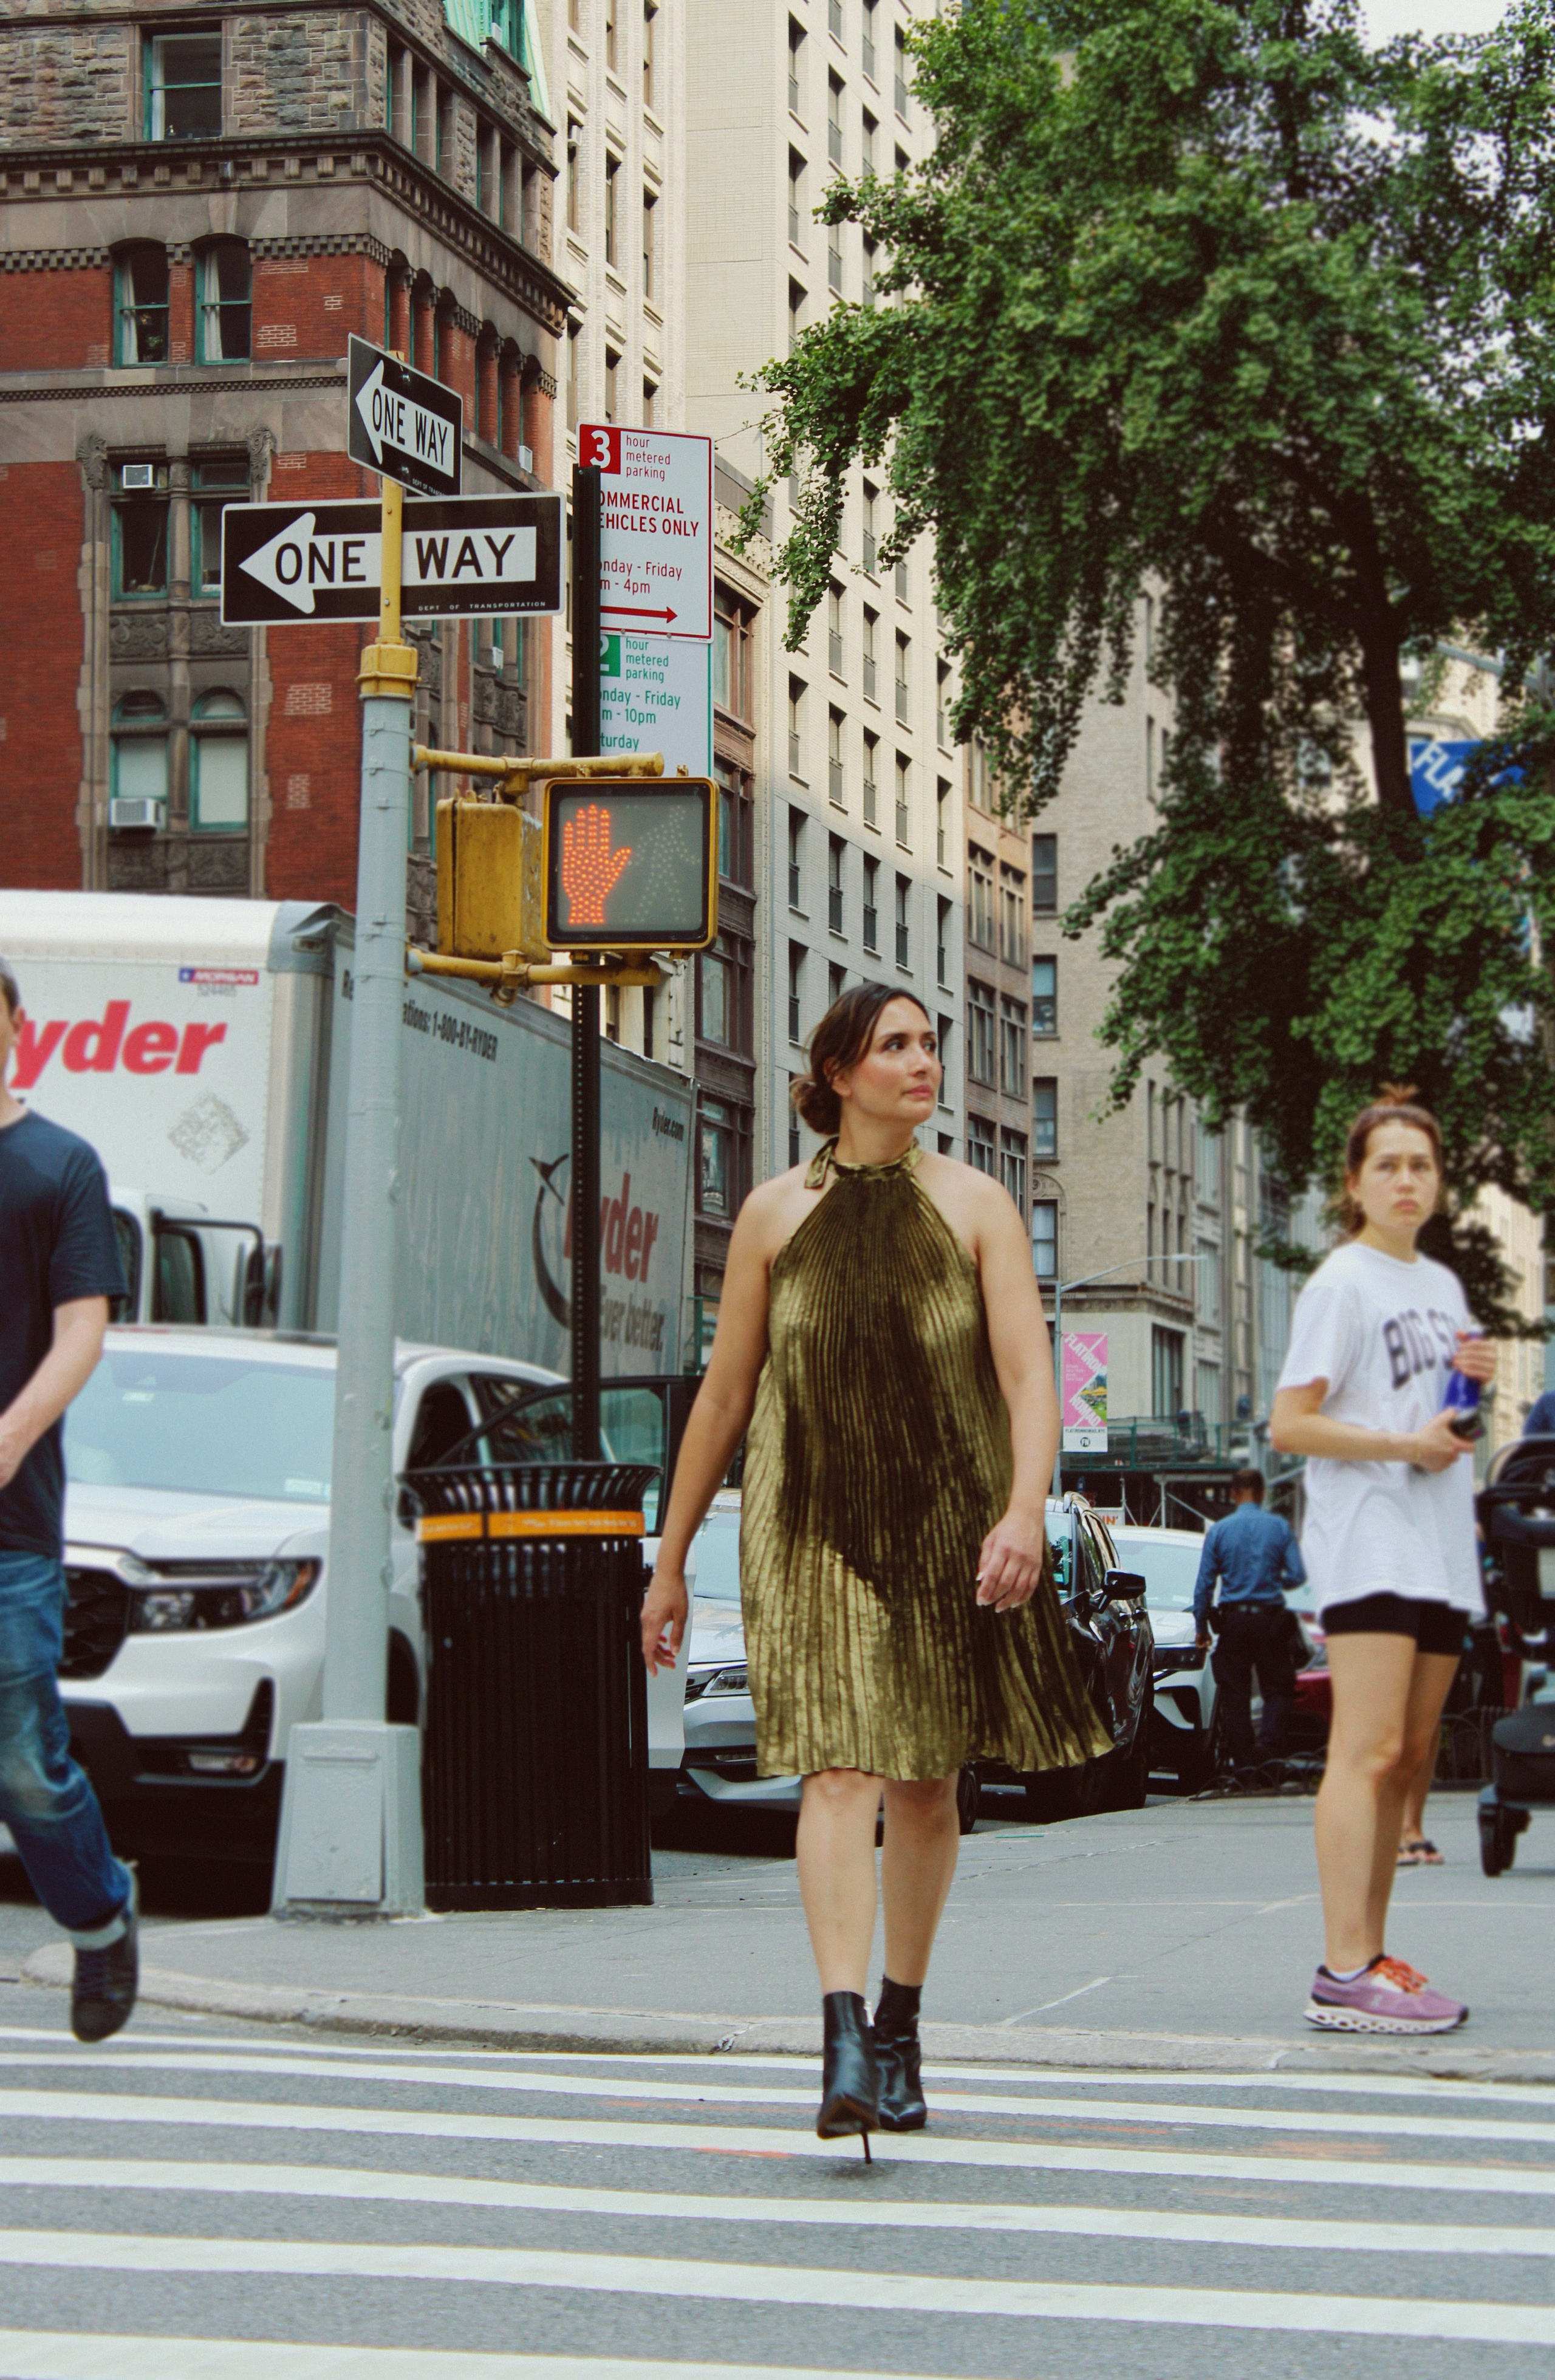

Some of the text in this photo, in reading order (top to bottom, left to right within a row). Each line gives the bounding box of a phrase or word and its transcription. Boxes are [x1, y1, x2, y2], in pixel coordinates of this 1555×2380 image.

[372, 388, 448, 465] ONE WAY
[589, 429, 611, 468] 3
[626, 434, 650, 448] hour
[626, 451, 671, 465] metered
[626, 465, 665, 482] parking
[600, 490, 684, 514] OMMERCIAL
[662, 518, 699, 537] ONLY
[275, 535, 516, 585] ONE WAY
[646, 561, 682, 581] Friday
[623, 578, 651, 595] 4pm
[626, 638, 649, 651] hour
[626, 654, 669, 667] metered
[626, 668, 665, 684] parking
[645, 690, 681, 710] Friday
[624, 708, 656, 726] 10pm
[600, 731, 640, 752] turday
[1415, 742, 1467, 803] FLA
[9, 999, 228, 1089] yder
[652, 1106, 685, 1142] Ryder.com
[1064, 1332, 1107, 1376] FLATIRON
[1070, 1395, 1102, 1428] NOMAD
